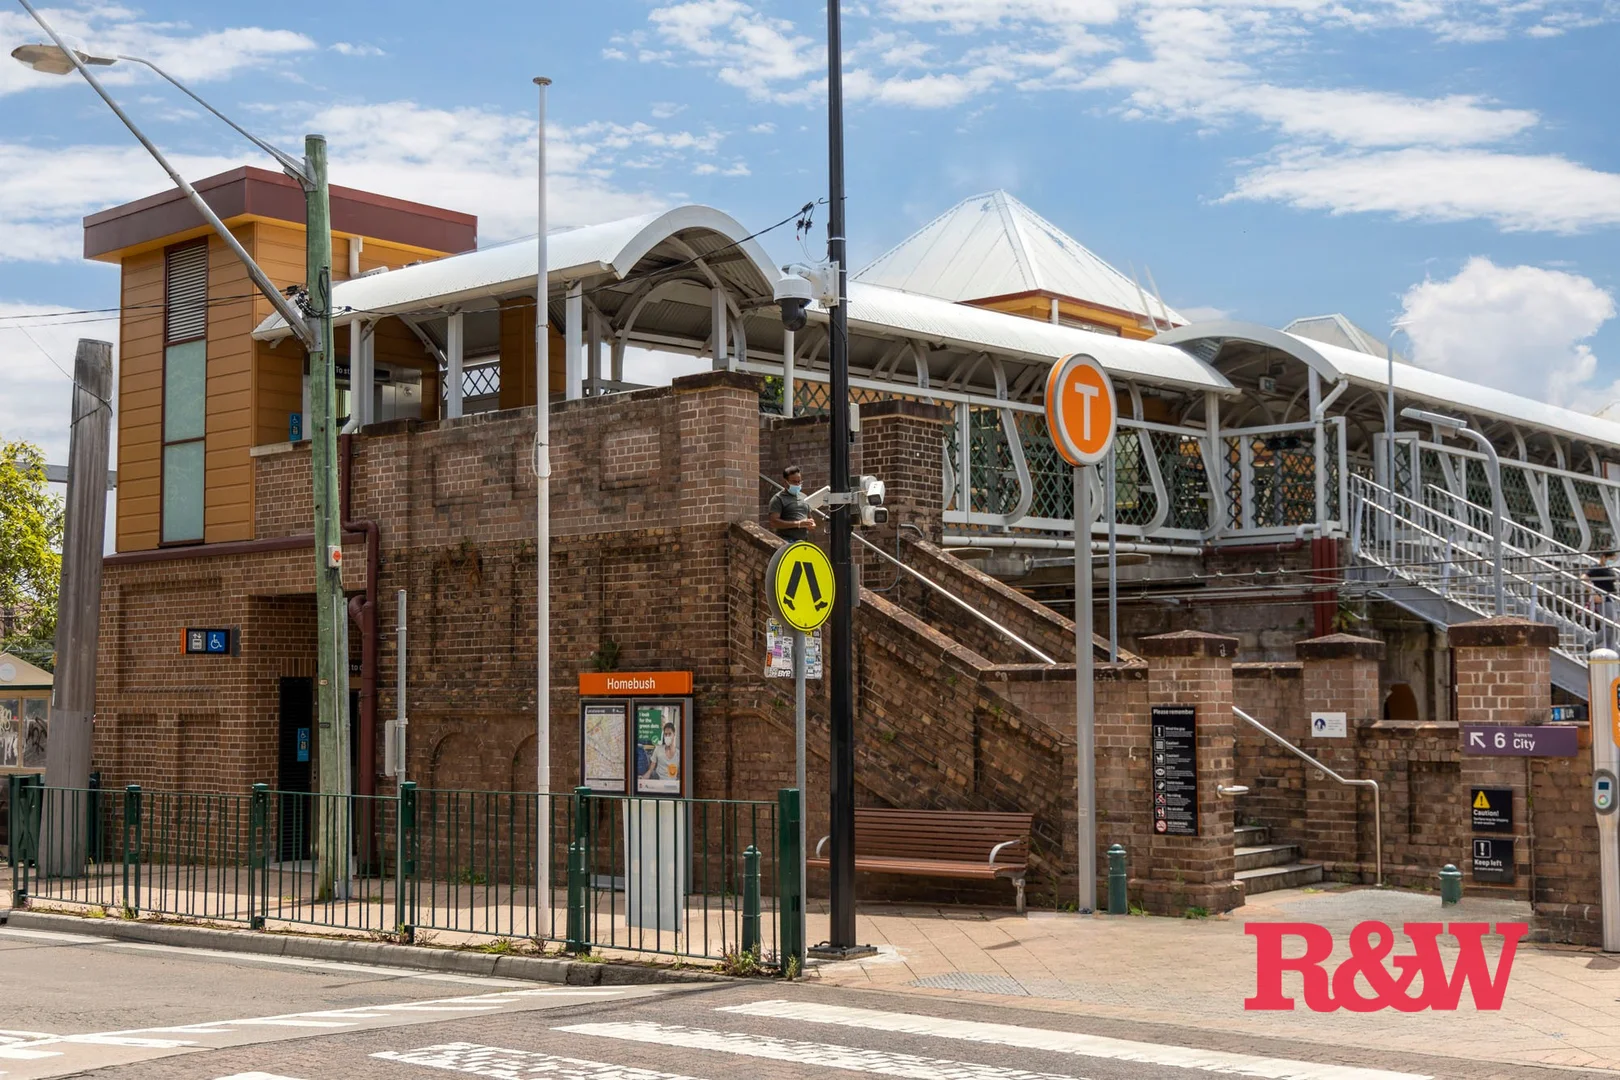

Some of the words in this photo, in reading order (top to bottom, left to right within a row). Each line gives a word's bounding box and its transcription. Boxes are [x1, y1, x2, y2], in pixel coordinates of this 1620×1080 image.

[1074, 382, 1099, 441] T
[607, 677, 656, 690] Homebush
[1494, 732, 1506, 748] 6
[1513, 739, 1535, 751] City
[1473, 809, 1500, 817] Caution!
[1474, 859, 1490, 867] Keep
